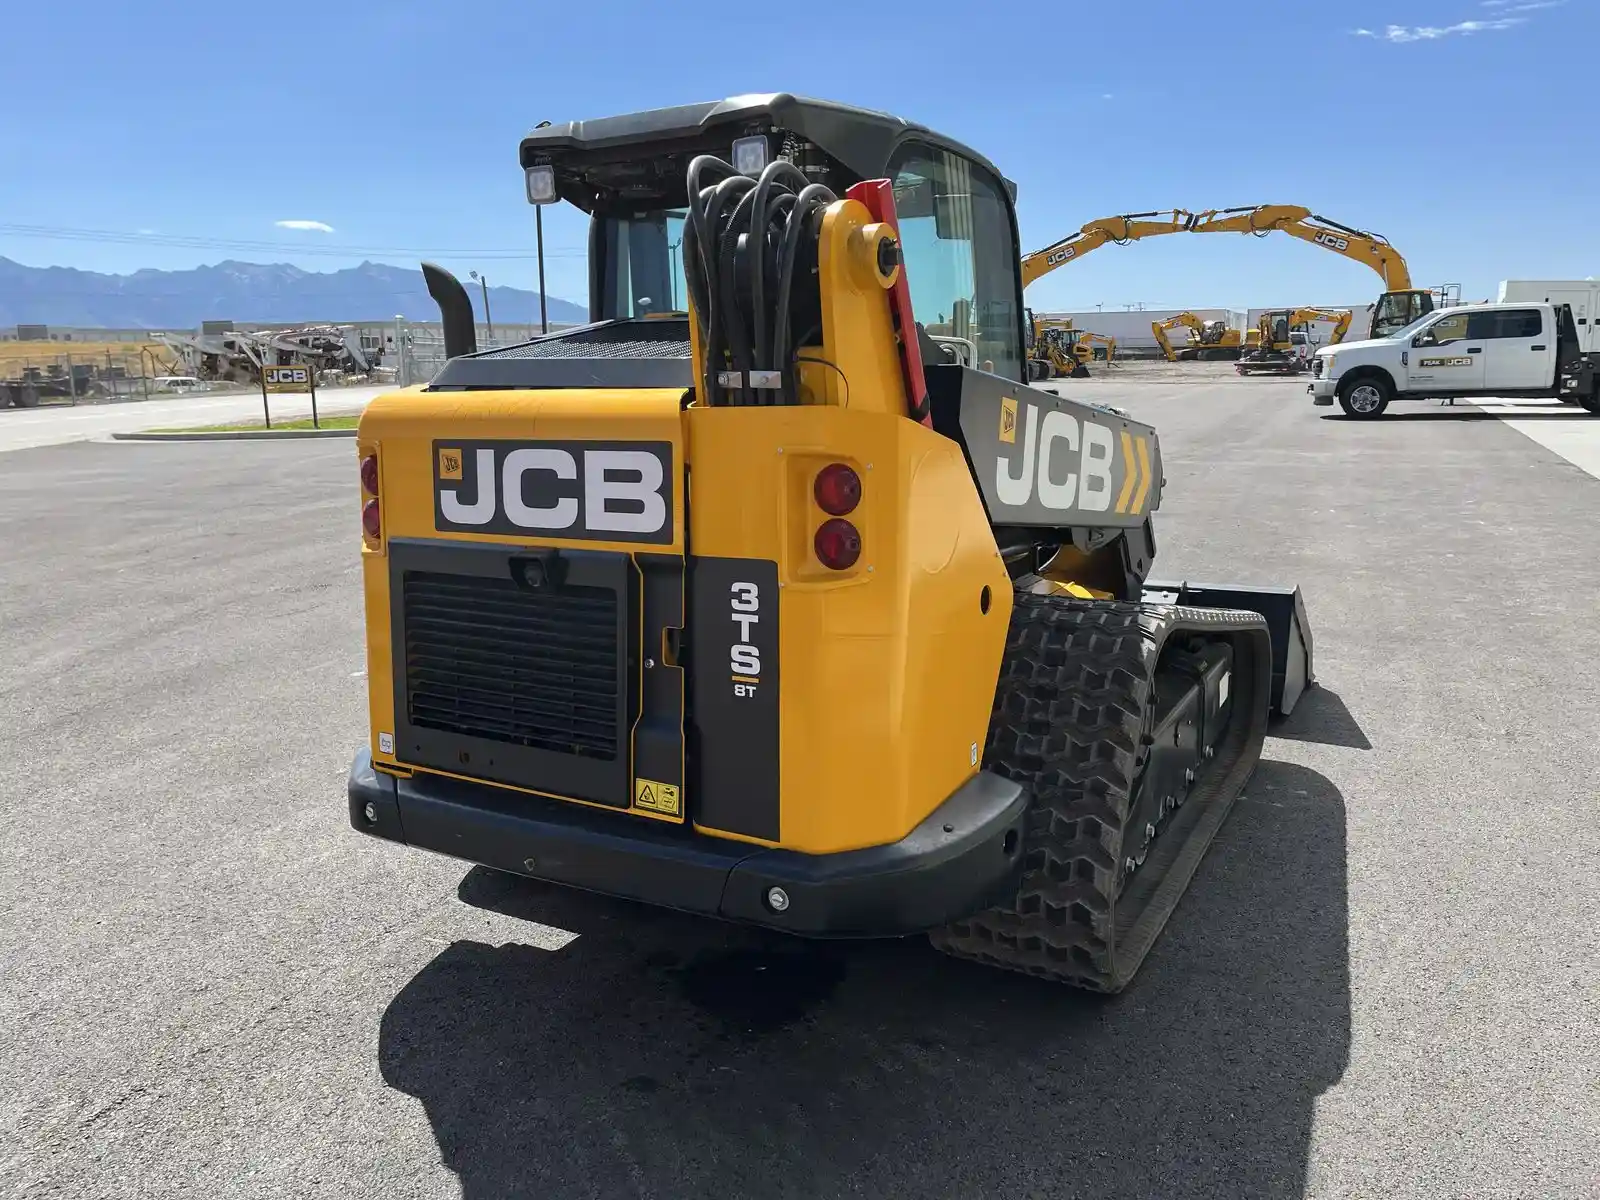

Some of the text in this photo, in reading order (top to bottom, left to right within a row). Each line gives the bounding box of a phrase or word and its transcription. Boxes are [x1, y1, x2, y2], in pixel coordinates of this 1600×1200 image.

[1315, 233, 1348, 250] JCB
[1048, 247, 1075, 265] JCB
[267, 369, 308, 383] JCB
[444, 455, 460, 472] JCB
[996, 403, 1114, 512] JCB
[440, 448, 666, 533] JCB
[730, 581, 761, 675] 3TS
[734, 684, 757, 698] 8T
